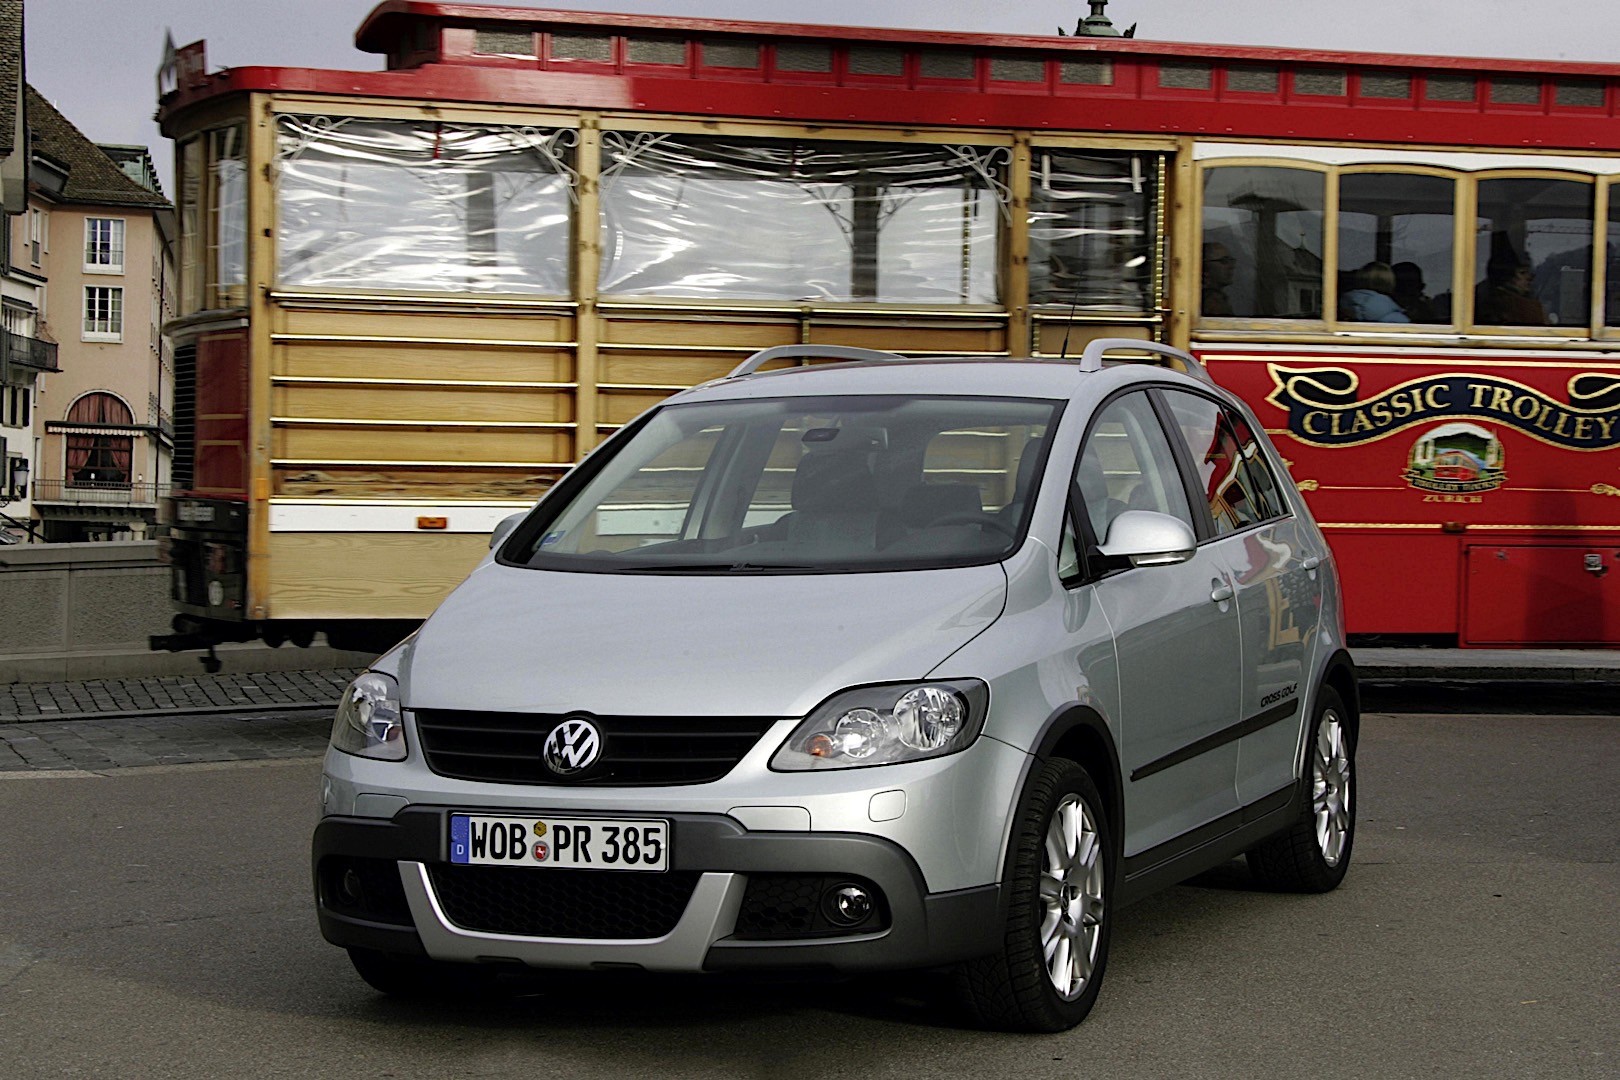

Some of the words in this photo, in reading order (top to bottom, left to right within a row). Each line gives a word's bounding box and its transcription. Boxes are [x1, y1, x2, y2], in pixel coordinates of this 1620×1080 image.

[1303, 384, 1451, 436] CLASSIC
[1468, 384, 1617, 439] TROLLEY
[1260, 690, 1280, 707] CROSS
[1281, 682, 1298, 698] GOLF
[544, 719, 599, 774] VW
[457, 844, 464, 855] D
[471, 821, 527, 860] WOB
[553, 825, 592, 862] PR
[602, 826, 661, 864] 385
